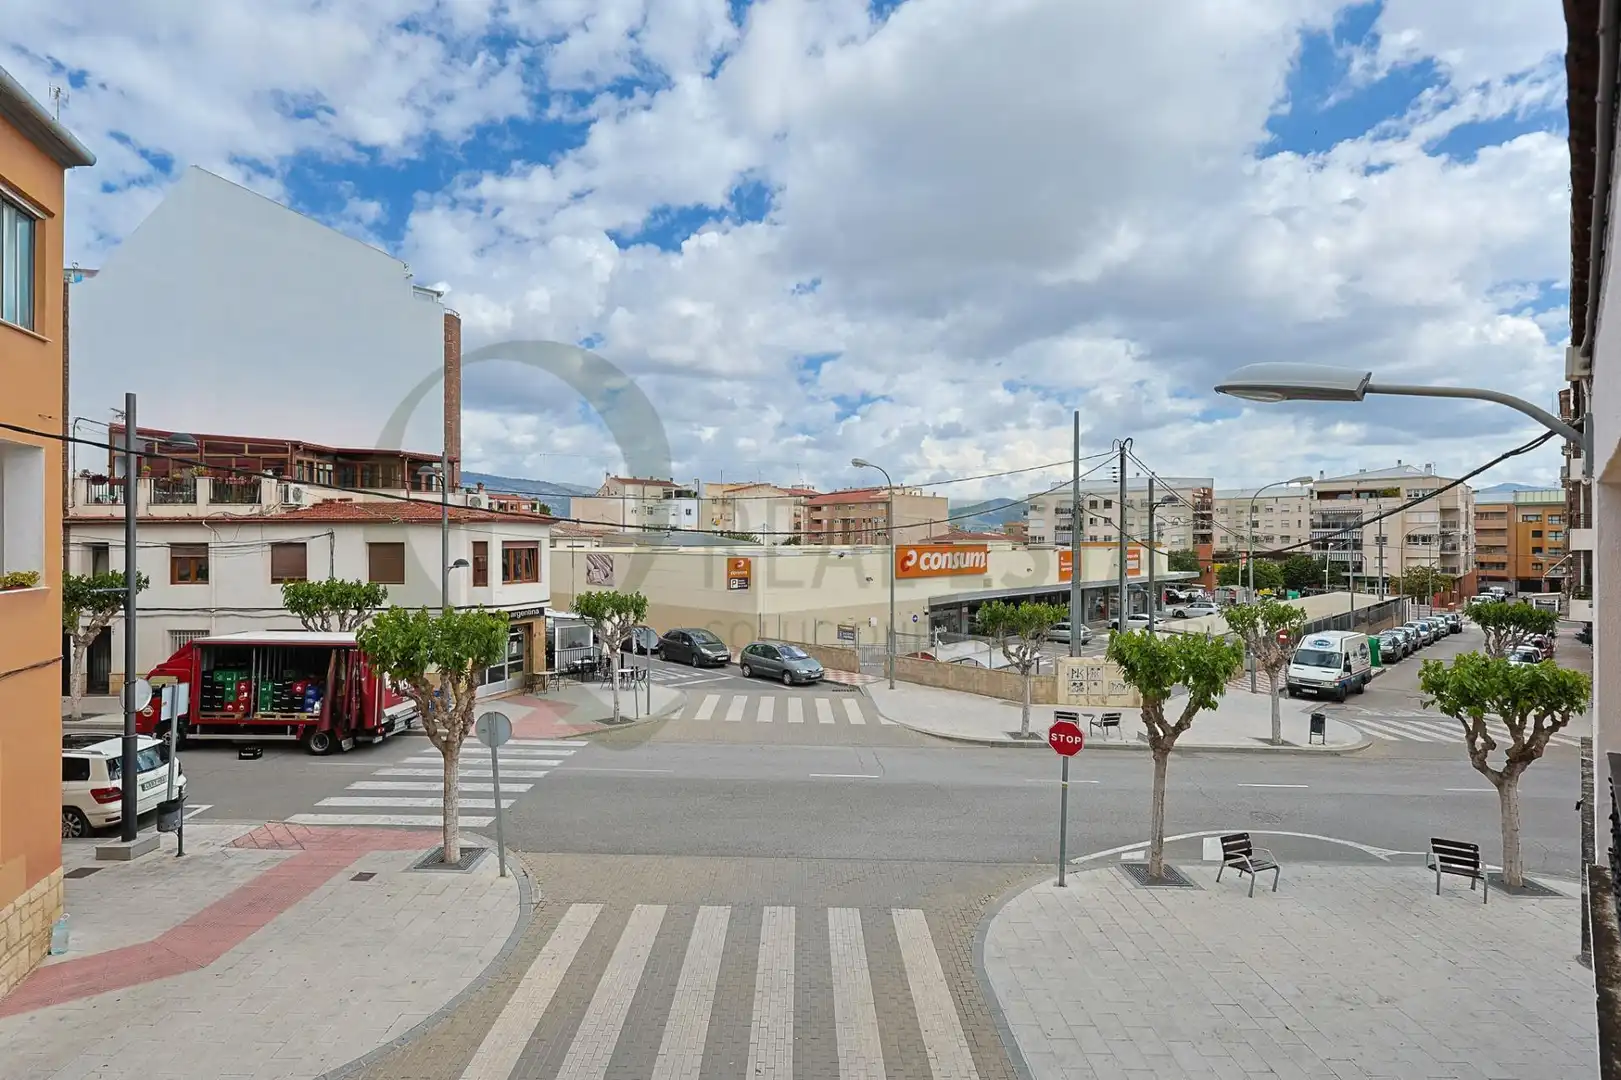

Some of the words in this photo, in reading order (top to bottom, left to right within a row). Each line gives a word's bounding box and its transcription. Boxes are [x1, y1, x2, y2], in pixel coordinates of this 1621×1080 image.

[920, 552, 986, 571] consum
[510, 608, 540, 619] argentina
[1051, 733, 1081, 744] STOP
